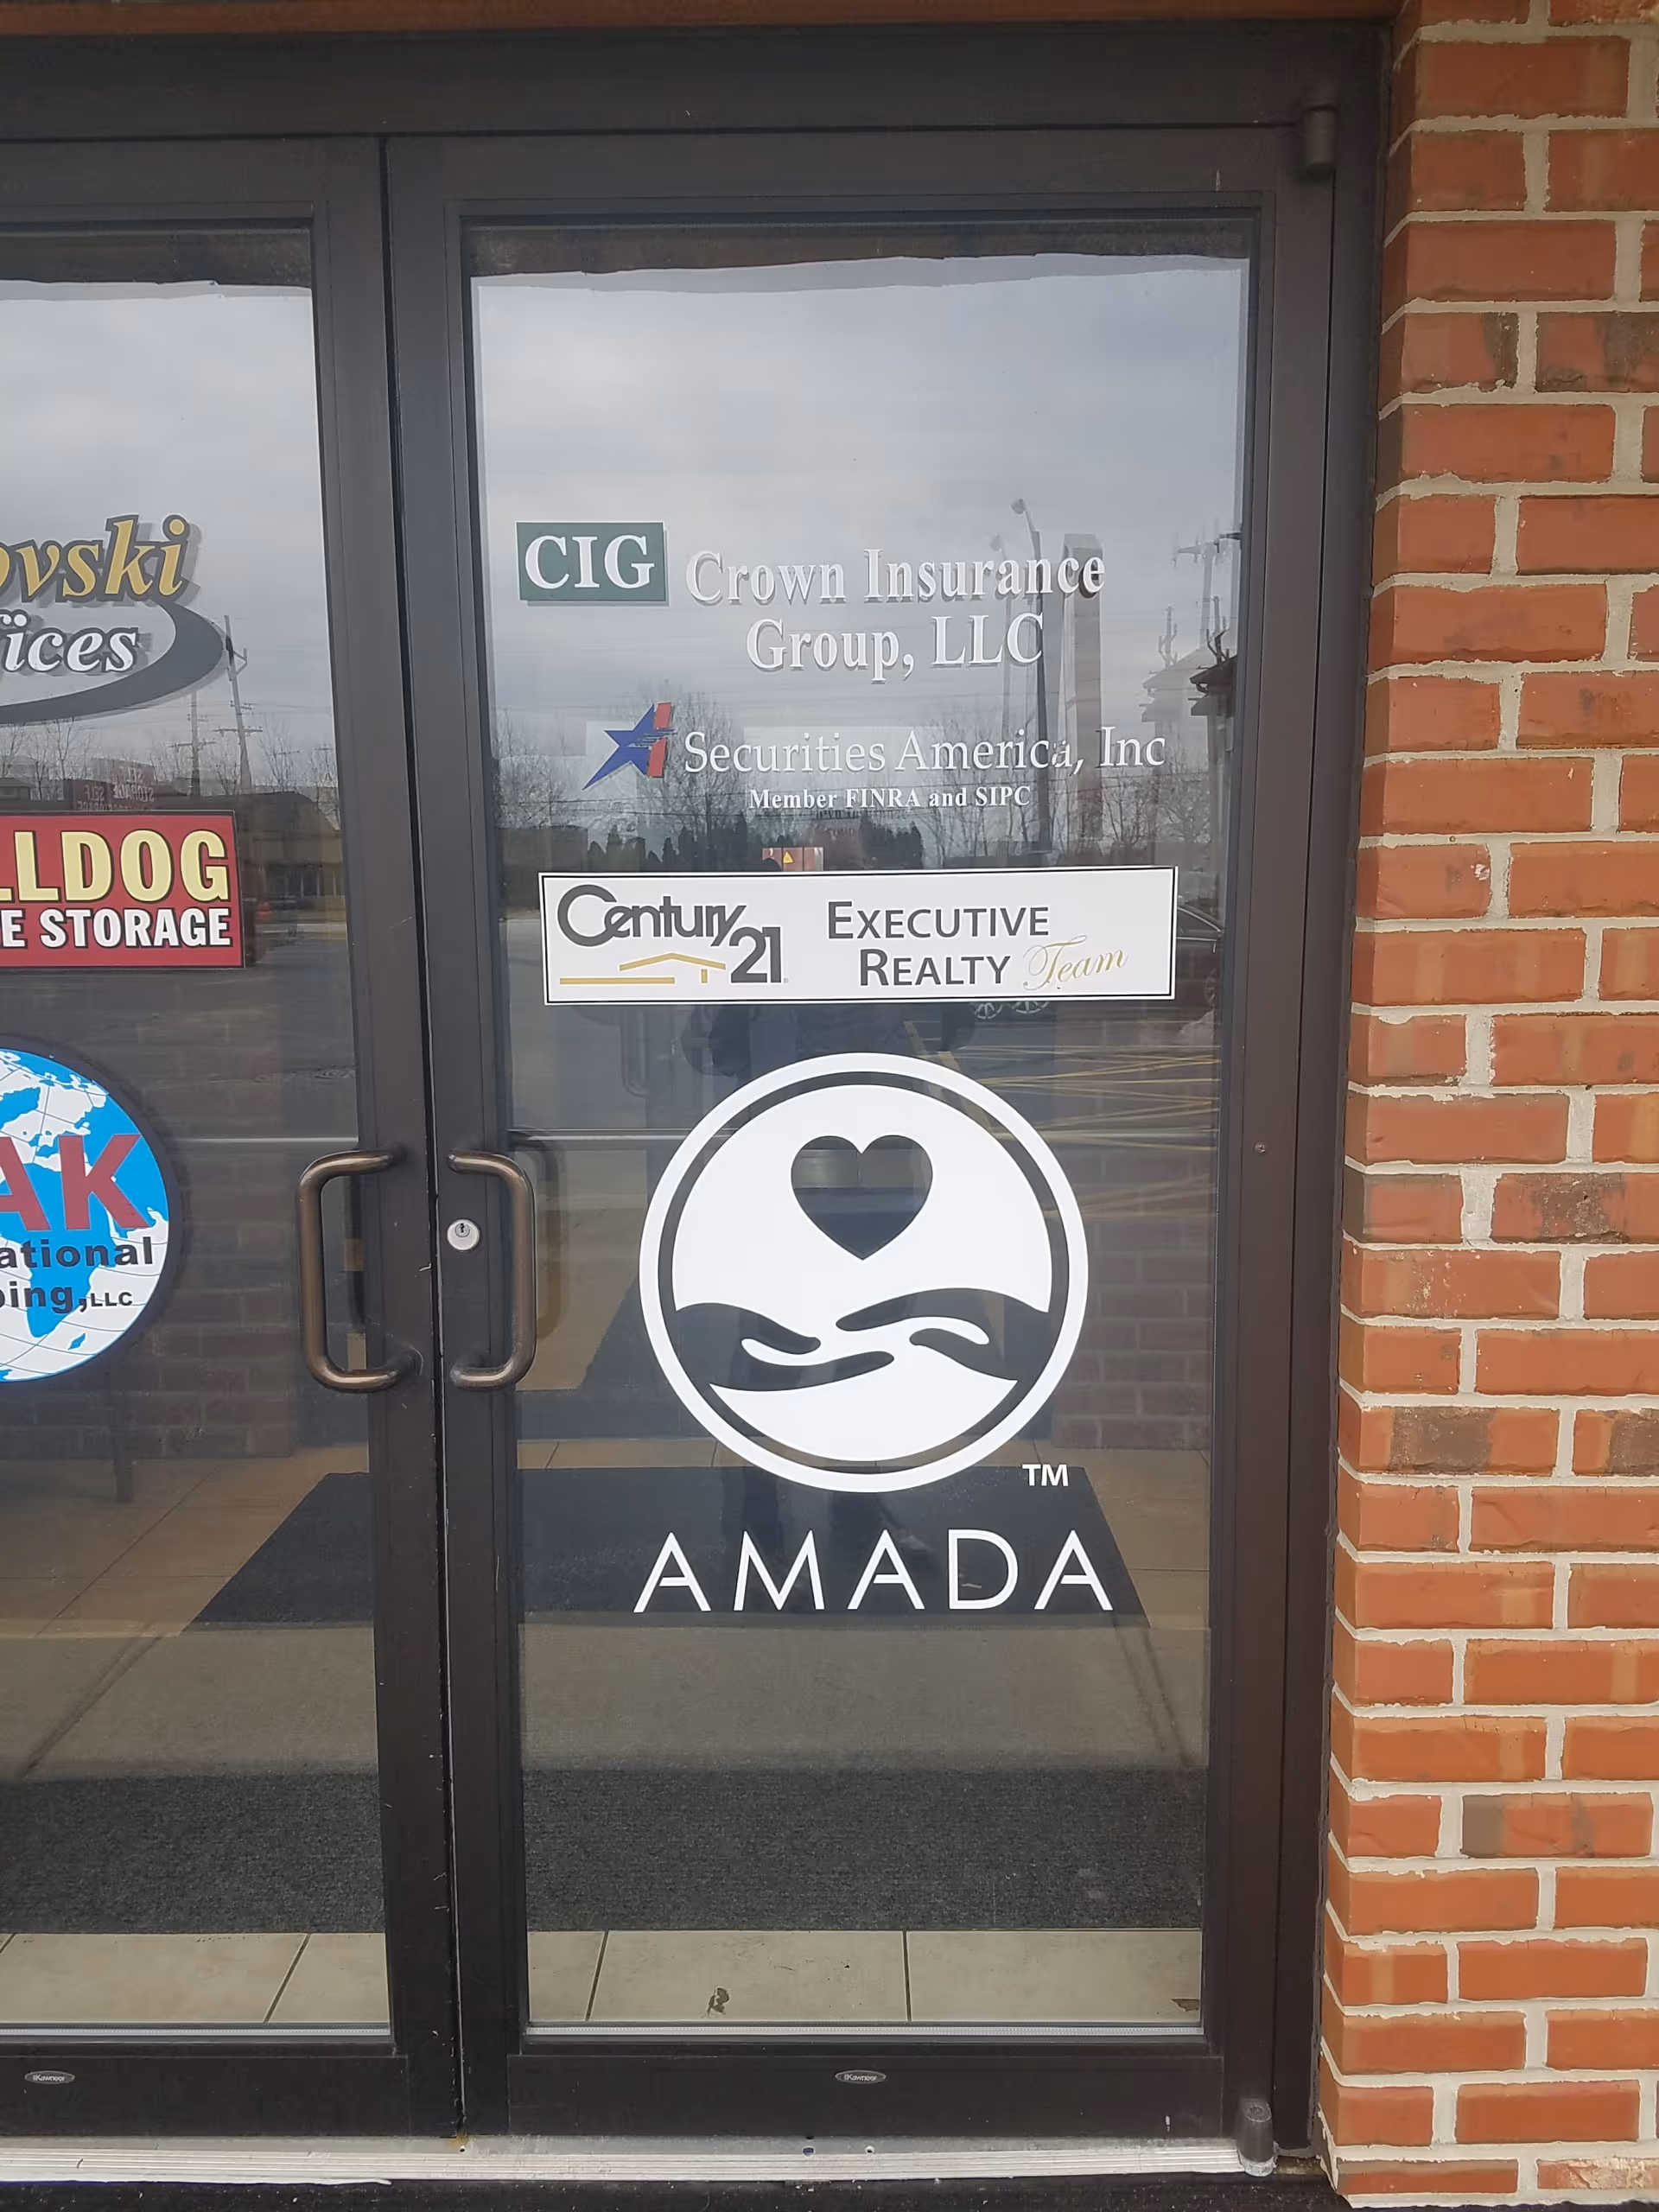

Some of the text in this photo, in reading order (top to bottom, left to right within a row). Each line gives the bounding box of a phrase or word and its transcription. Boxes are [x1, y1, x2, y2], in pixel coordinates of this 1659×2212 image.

[524, 534, 656, 589] CIG
[686, 549, 1105, 603] Crown Insurance
[746, 613, 1043, 683] Group, LLC
[684, 726, 1166, 777] Securities America, Inc
[748, 785, 1032, 810] Member FINRA and SIPC
[0, 830, 230, 902] LDOG
[39, 908, 232, 948] STORAGE
[557, 884, 747, 947] Century
[827, 900, 1050, 940] EXECUTIVE
[860, 935, 1128, 991] REALTY Team
[0, 1281, 87, 1314] ing,
[1022, 1464, 1070, 1487] TM
[632, 1529, 1114, 1613] AMADA
